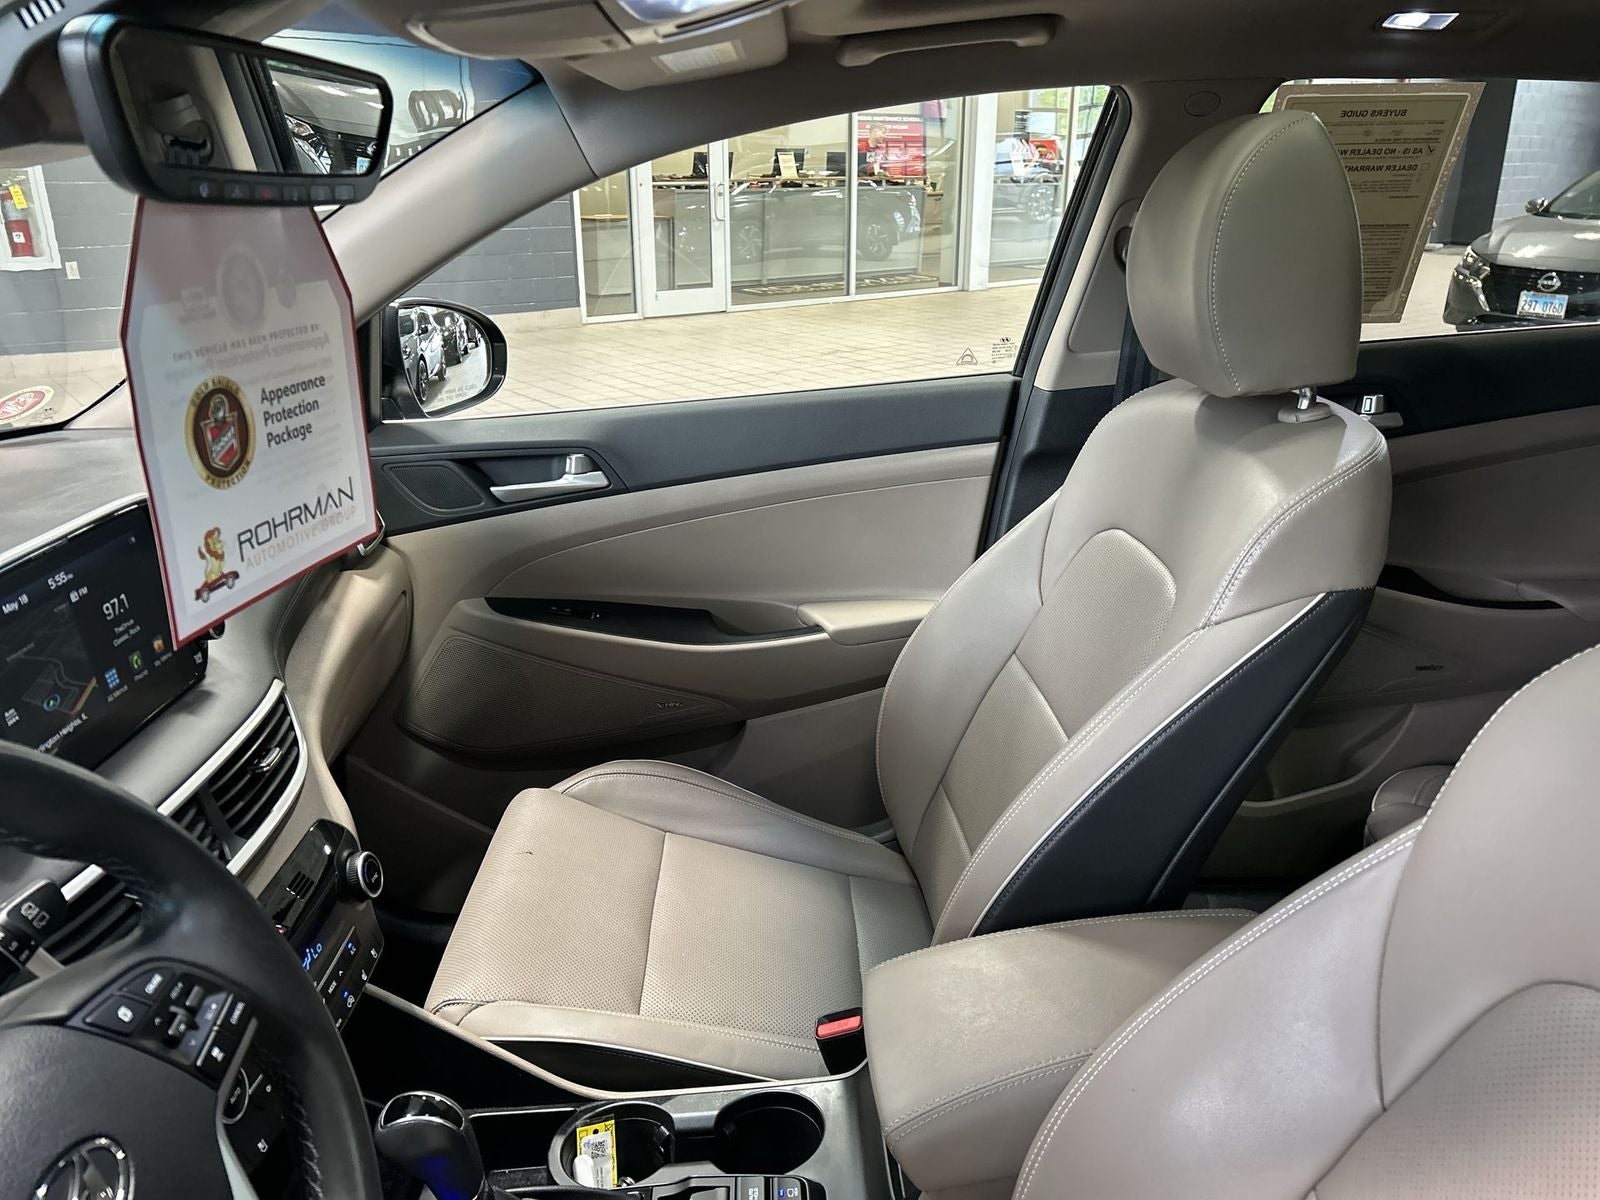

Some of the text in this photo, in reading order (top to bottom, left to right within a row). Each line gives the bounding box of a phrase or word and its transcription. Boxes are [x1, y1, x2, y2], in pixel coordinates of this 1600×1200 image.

[194, 343, 228, 359] VEHICLE
[268, 325, 308, 342] PROTECTED
[260, 374, 326, 407] Appearance
[262, 398, 320, 427] Protection
[266, 421, 313, 449] Package
[205, 458, 251, 489] PROTECTION
[237, 475, 354, 562] ROHRMAN
[245, 505, 357, 571] AUTOMOTIVE GROUP
[2, 600, 20, 615] May
[102, 593, 130, 621] 97.1
[230, 1087, 242, 1105] AUTO
